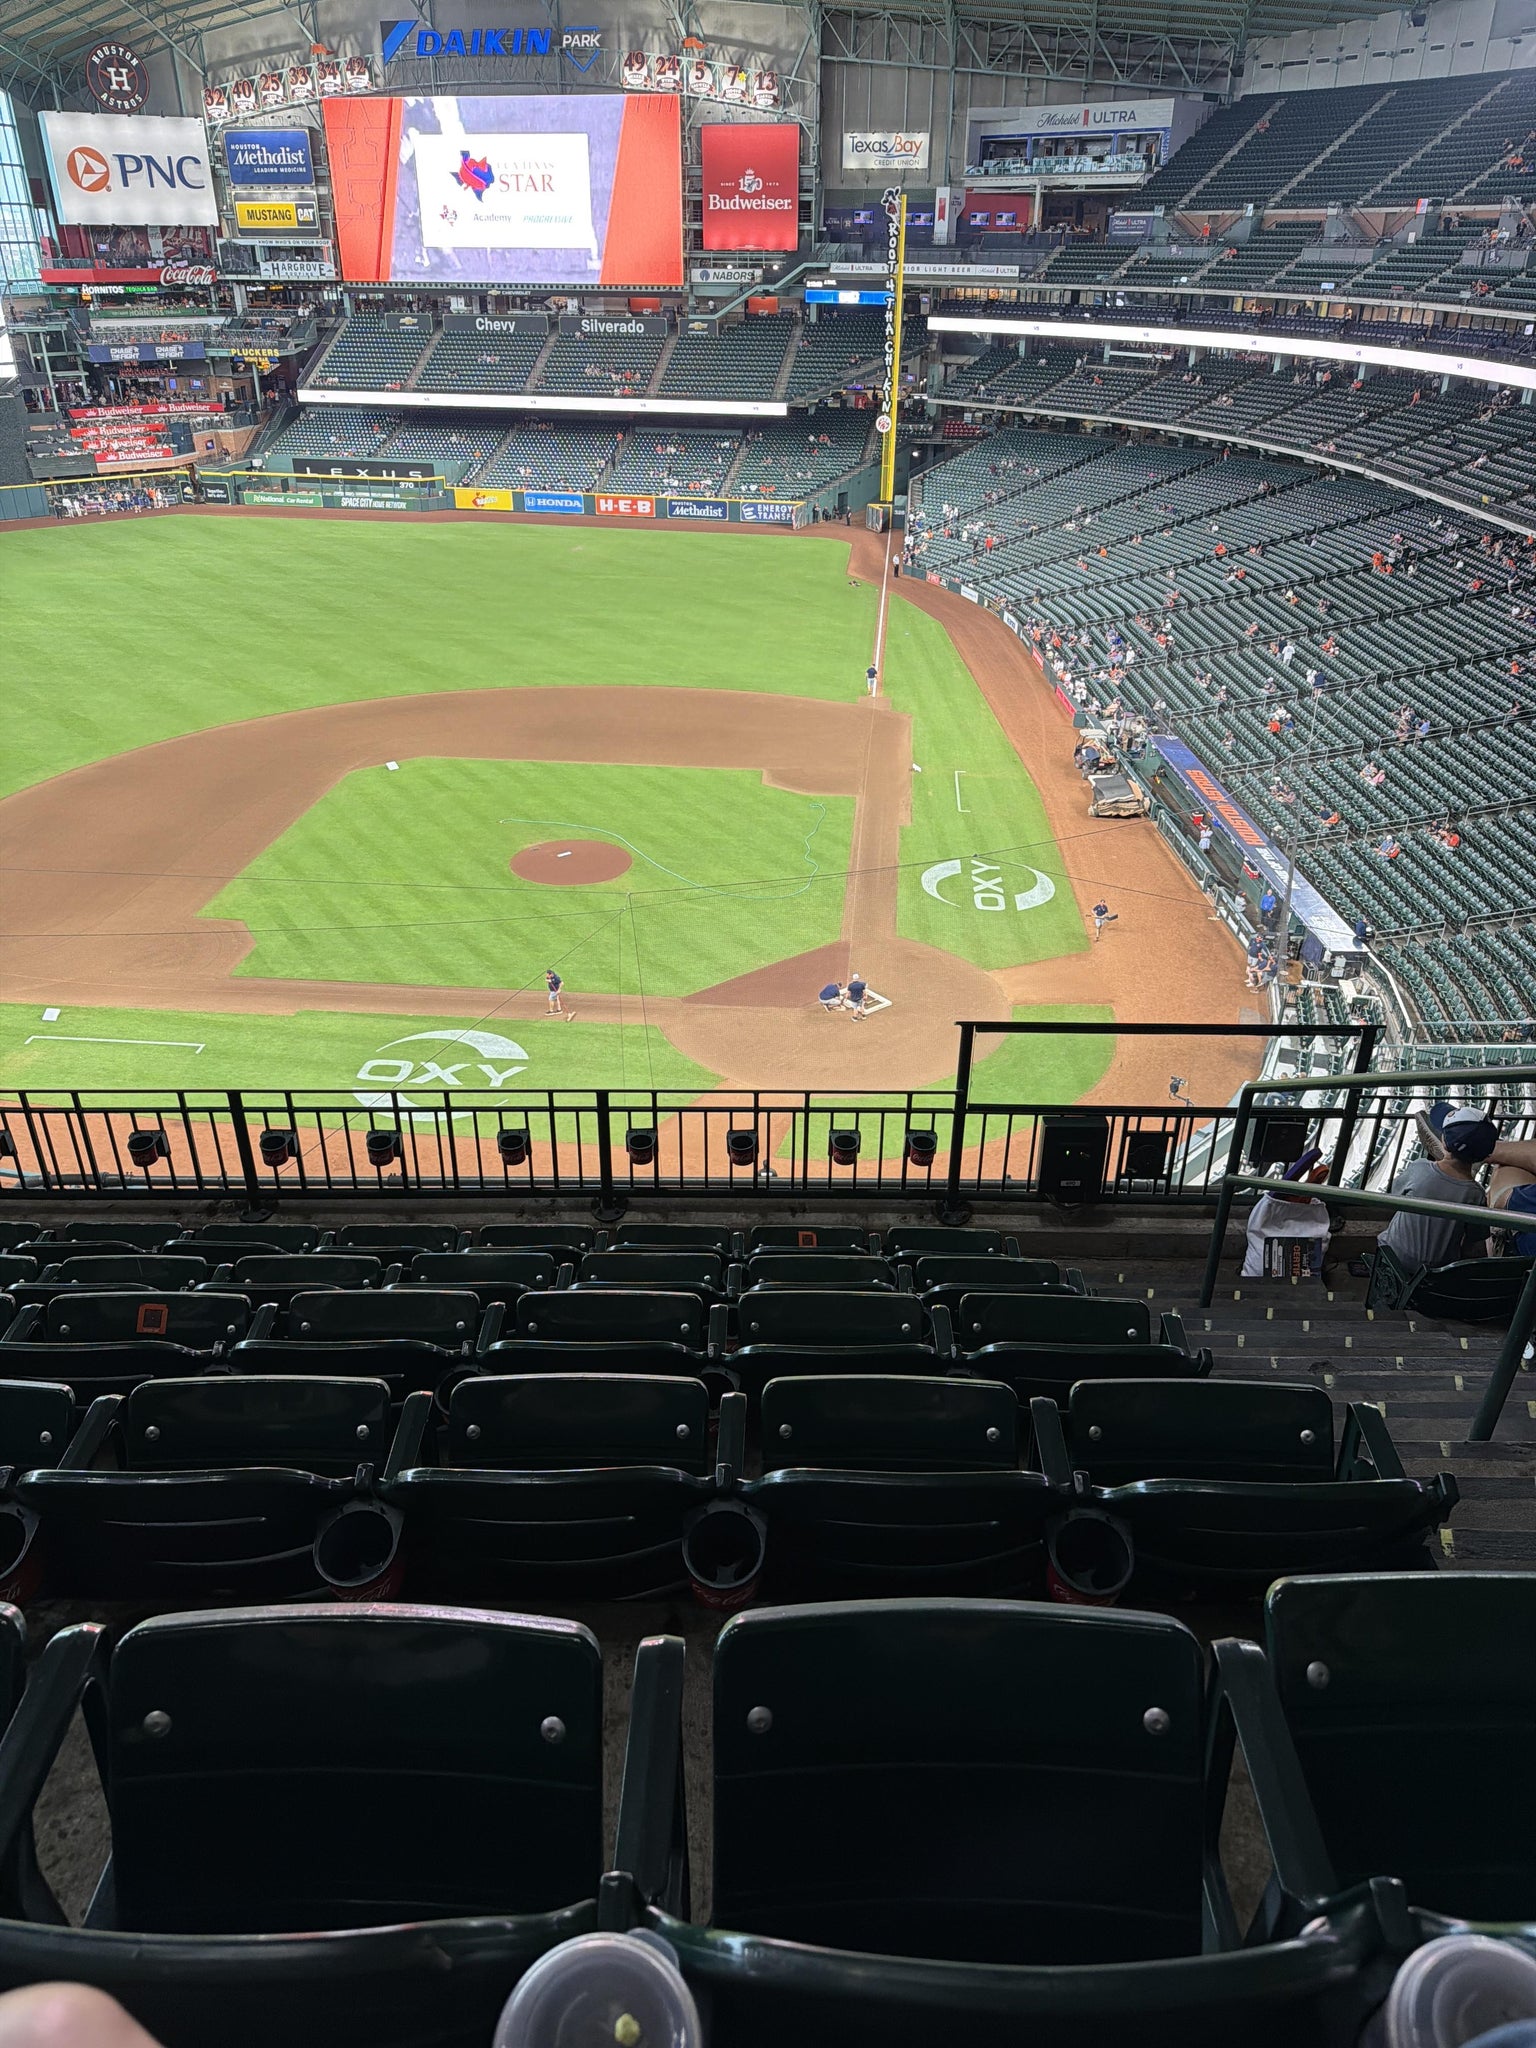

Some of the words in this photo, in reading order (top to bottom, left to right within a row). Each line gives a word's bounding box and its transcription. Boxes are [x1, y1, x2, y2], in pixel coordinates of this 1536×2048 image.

[416, 28, 552, 57] DAIKIN
[562, 34, 601, 47] PARK
[92, 46, 138, 66] HOUSTON
[624, 52, 645, 71] 49
[317, 62, 338, 80] 34
[345, 57, 366, 76] 42
[655, 55, 677, 75] 24
[695, 61, 706, 80] 5
[106, 67, 131, 90] H
[259, 73, 280, 92] 25
[289, 67, 309, 85] 33
[727, 66, 740, 86] 7
[756, 72, 776, 91] 13
[204, 88, 225, 106] 32
[232, 80, 252, 98] 40
[101, 92, 142, 109] ASTROS
[1036, 112, 1080, 127] Michelob
[1093, 110, 1137, 123] ULTRA
[849, 136, 888, 153] Texas
[894, 136, 923, 158] Bay
[234, 147, 305, 165] Methodist
[112, 154, 205, 189] PNC
[499, 174, 555, 192] STAR
[247, 209, 292, 221] MUSTANG
[297, 209, 314, 221] CAT
[473, 213, 512, 224] Academy
[271, 263, 326, 276] HARGROVE
[712, 272, 752, 281] NABORS
[82, 285, 124, 294] HORNITOS
[475, 317, 516, 333] Chevy
[581, 319, 645, 333] Silverado
[231, 348, 280, 357] PLUCKERS
[882, 341, 893, 413] CHIKIN
[98, 406, 143, 416] Budweiser
[169, 403, 210, 412] Budweiser
[100, 424, 145, 435] Budweiser
[100, 437, 147, 448] Bweiser
[118, 449, 164, 460] Budweiser
[306, 467, 422, 479] LEXUS
[400, 481, 414, 489] 370
[259, 495, 284, 503] National
[341, 497, 359, 507] SPACE
[359, 498, 373, 508] CITY
[537, 499, 582, 507] HONDA
[600, 498, 651, 513] H-E-B
[672, 504, 723, 518] Methodist
[757, 504, 792, 513] ENERGY
[757, 511, 795, 520] TRANSF
[970, 859, 1006, 911] OXY
[356, 1059, 528, 1088] OXY
